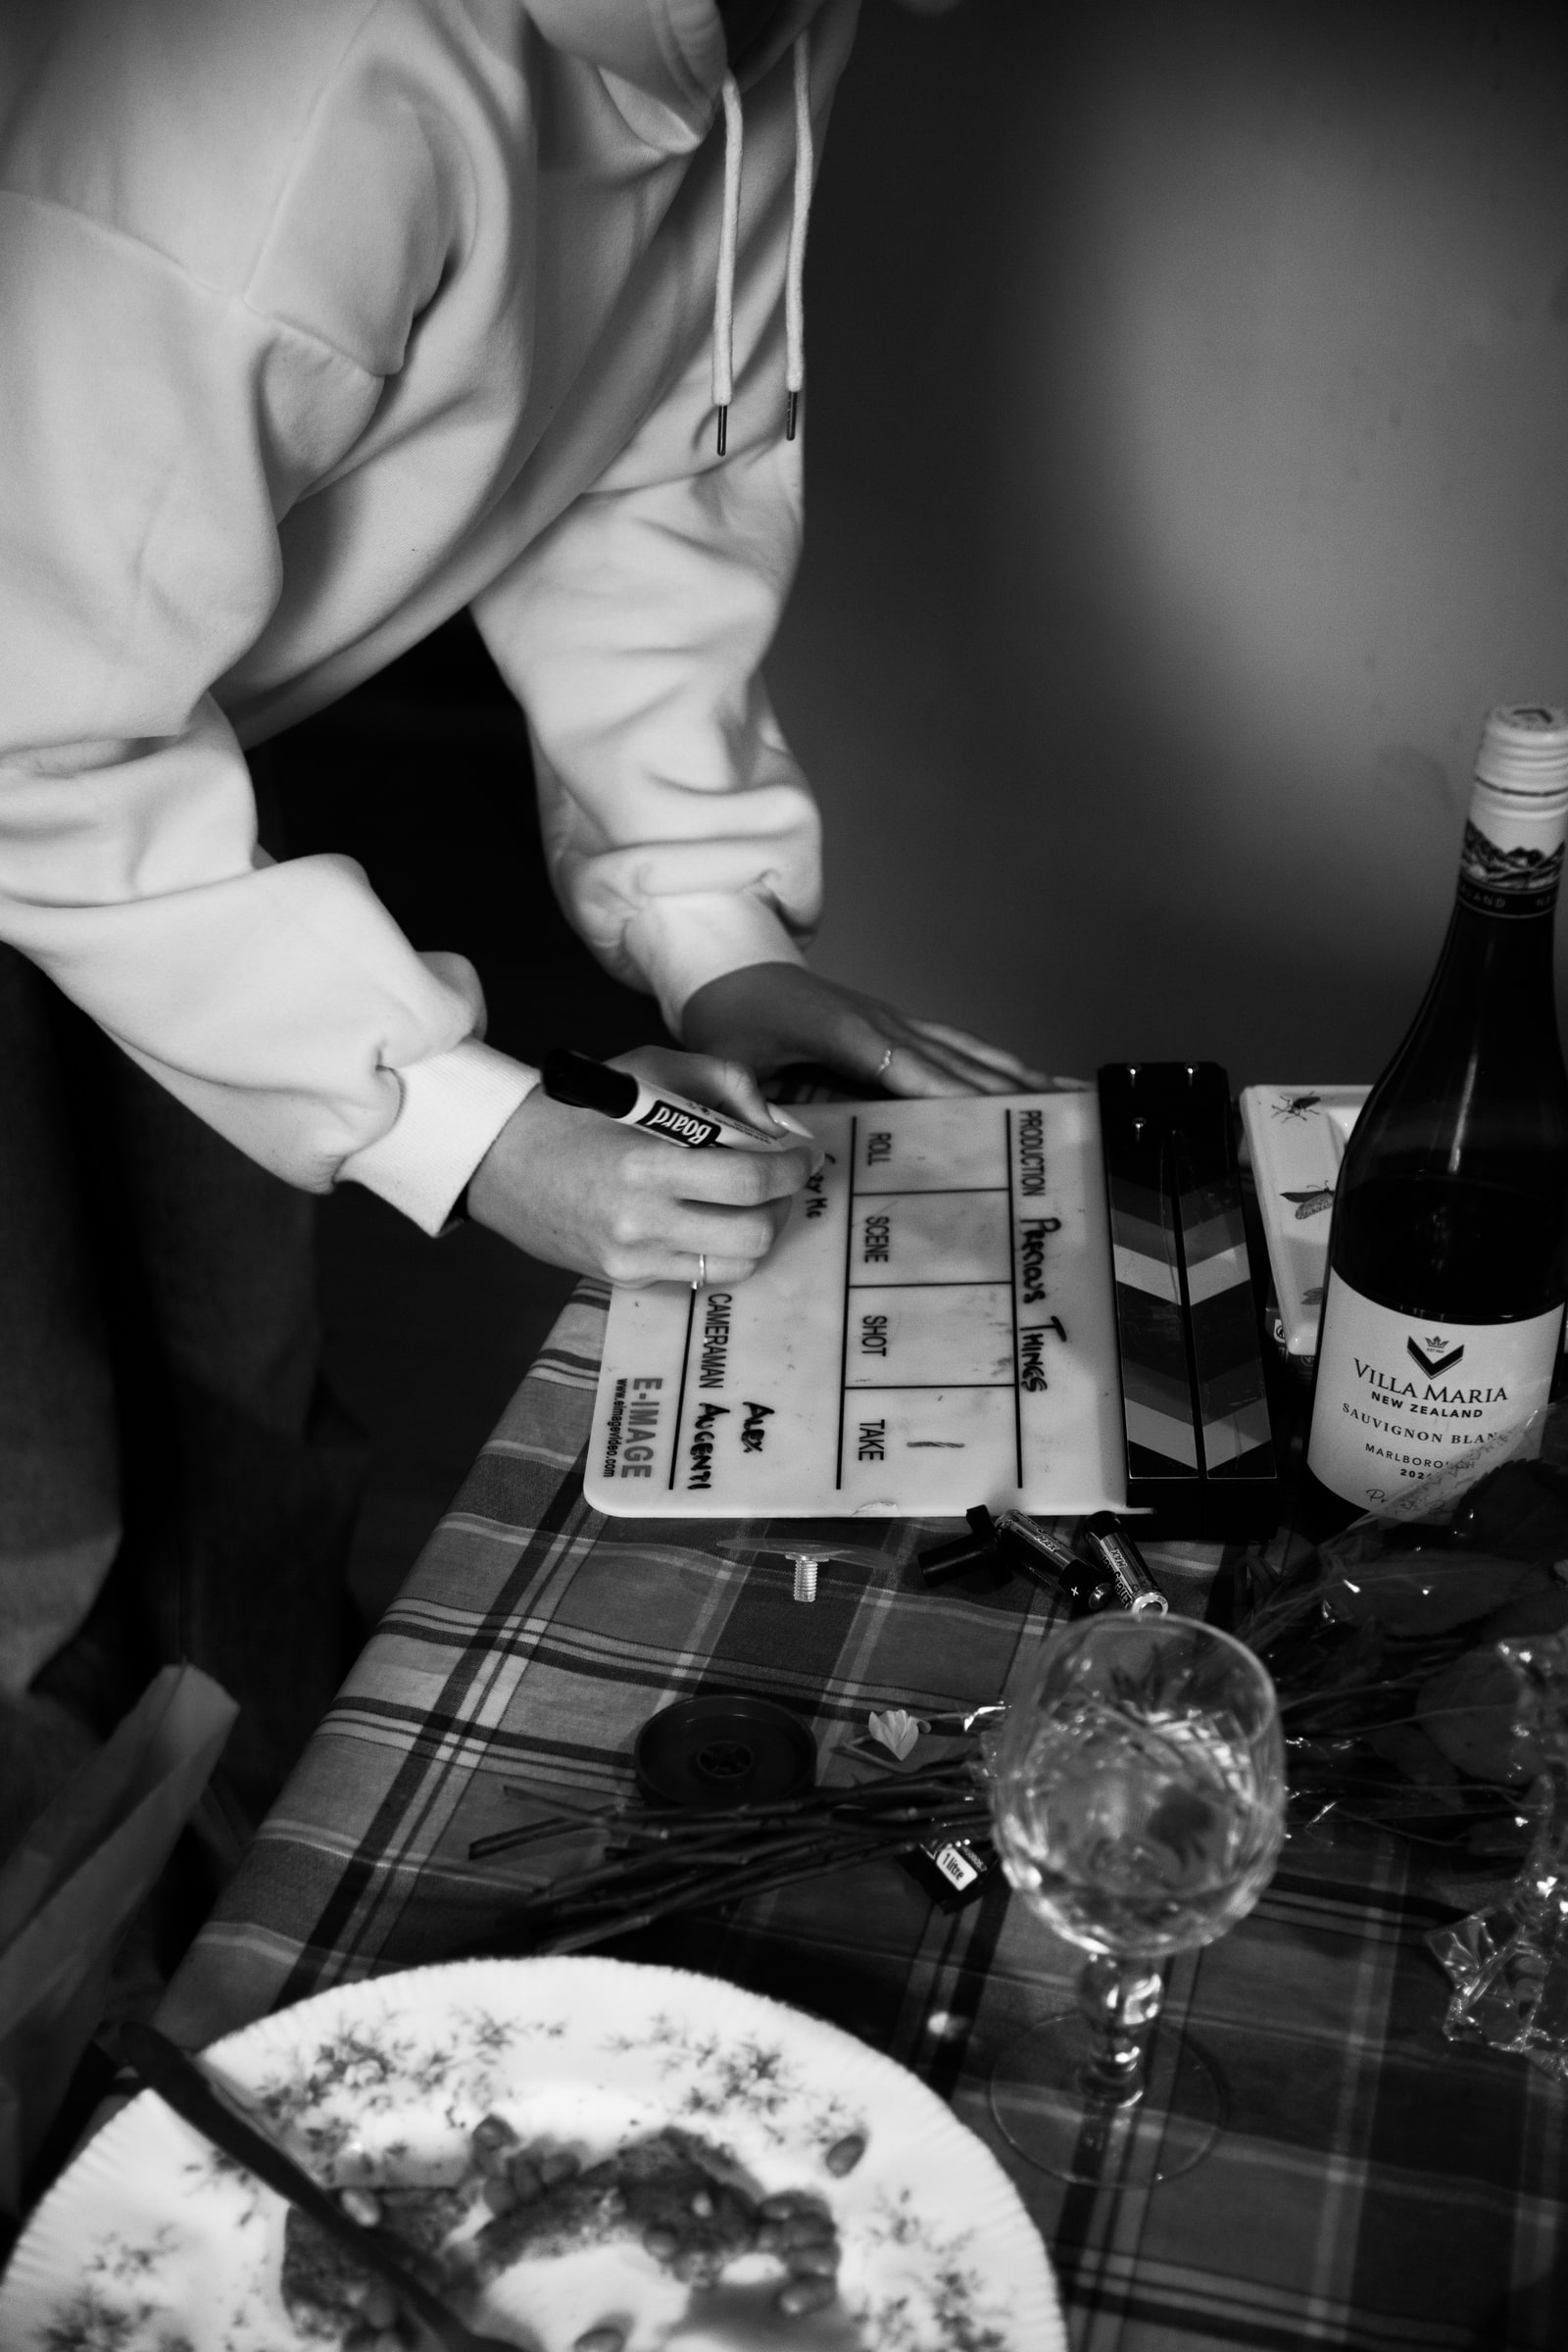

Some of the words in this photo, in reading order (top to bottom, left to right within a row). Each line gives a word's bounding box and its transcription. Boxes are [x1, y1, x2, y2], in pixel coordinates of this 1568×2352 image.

[646, 1105, 712, 1145] Board
[867, 1133, 892, 1166] ROLL
[1017, 1110, 1046, 1196] PRODUCTION
[864, 1216, 890, 1263] SCENE
[700, 1294, 732, 1389] CAMERAMAN
[861, 1315, 887, 1356] SHOT
[1342, 1401, 1444, 1444] SAUVIGNON
[1371, 1391, 1404, 1409] NEW
[1409, 1403, 1484, 1418] ZEALAND
[603, 1378, 629, 1478] www.eimagevideo.com
[621, 1378, 663, 1479] E-IMAGE
[858, 1419, 886, 1461] TAKE
[1034, 1534, 1060, 1552] MAX
[1109, 1548, 1128, 1569] MAX
[943, 1852, 952, 1866] 1
[946, 1857, 964, 1882] litre
